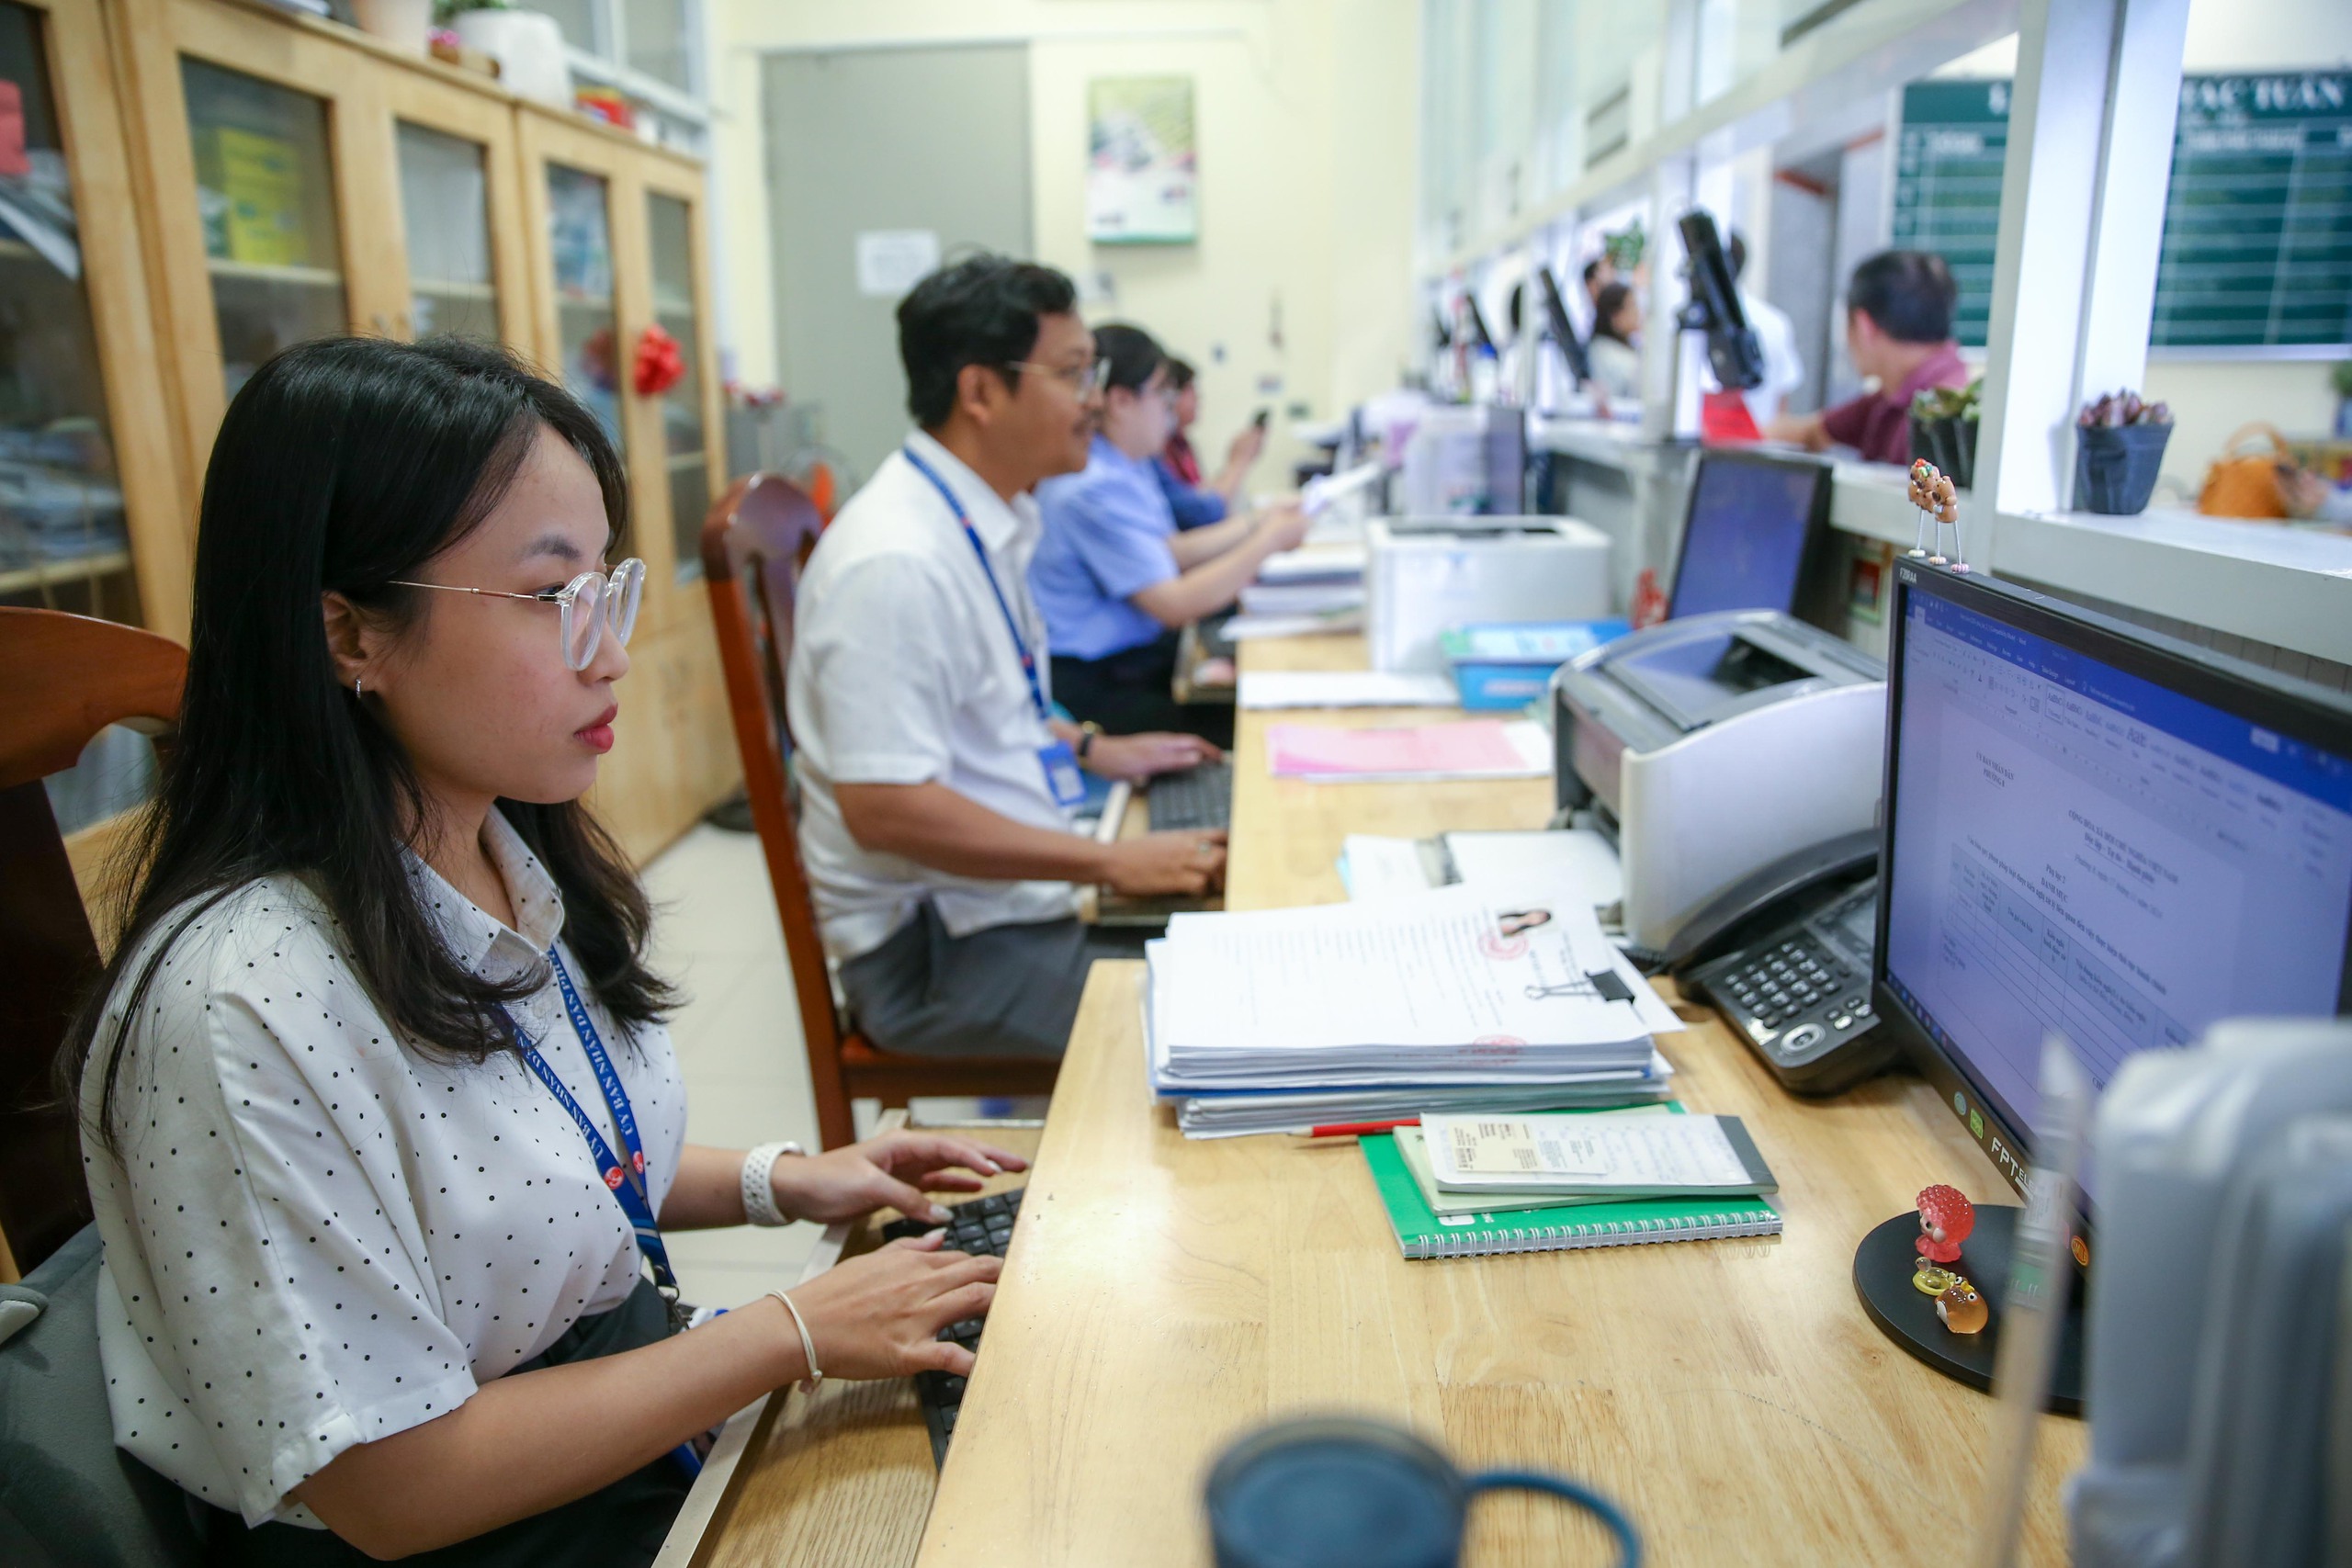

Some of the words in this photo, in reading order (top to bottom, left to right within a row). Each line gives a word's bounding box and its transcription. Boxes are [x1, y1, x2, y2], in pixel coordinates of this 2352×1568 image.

[603, 1076, 625, 1110] BAN
[571, 1106, 592, 1135] BAN
[1991, 1136, 2019, 1177] FPT
